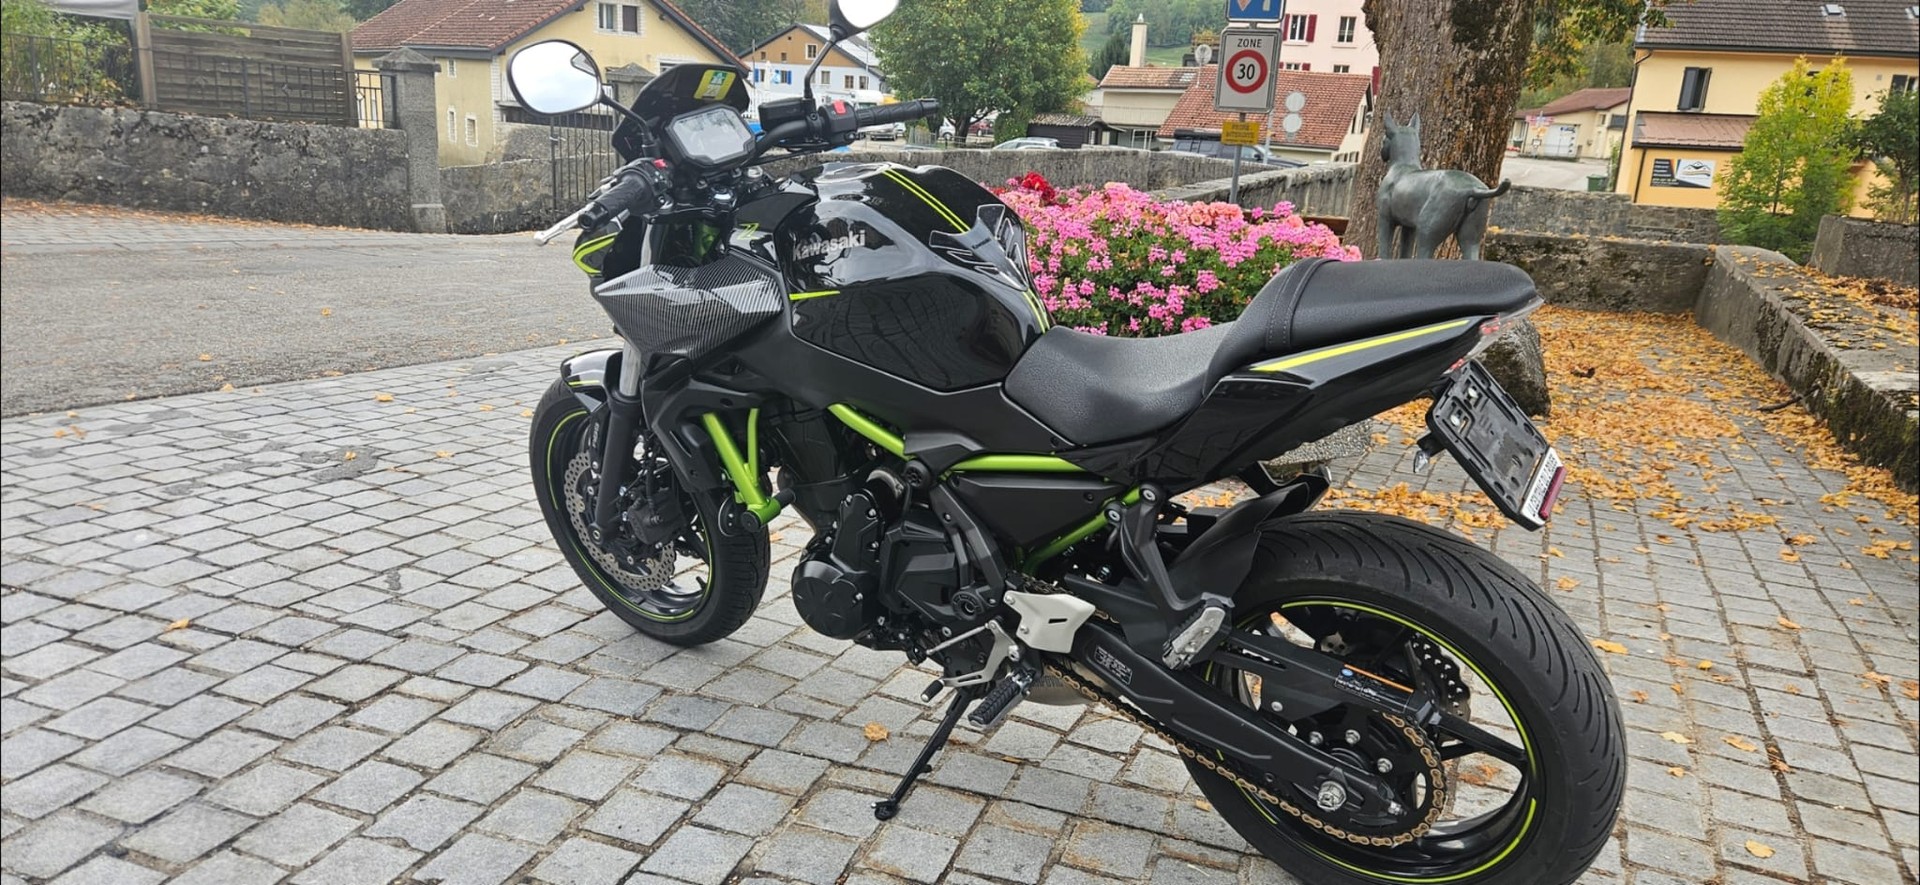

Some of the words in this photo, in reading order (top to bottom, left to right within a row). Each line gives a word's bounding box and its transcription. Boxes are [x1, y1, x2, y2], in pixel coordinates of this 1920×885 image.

[1237, 38, 1262, 48] ZONE
[1237, 63, 1255, 80] 30
[792, 229, 866, 262] Kawasaki
